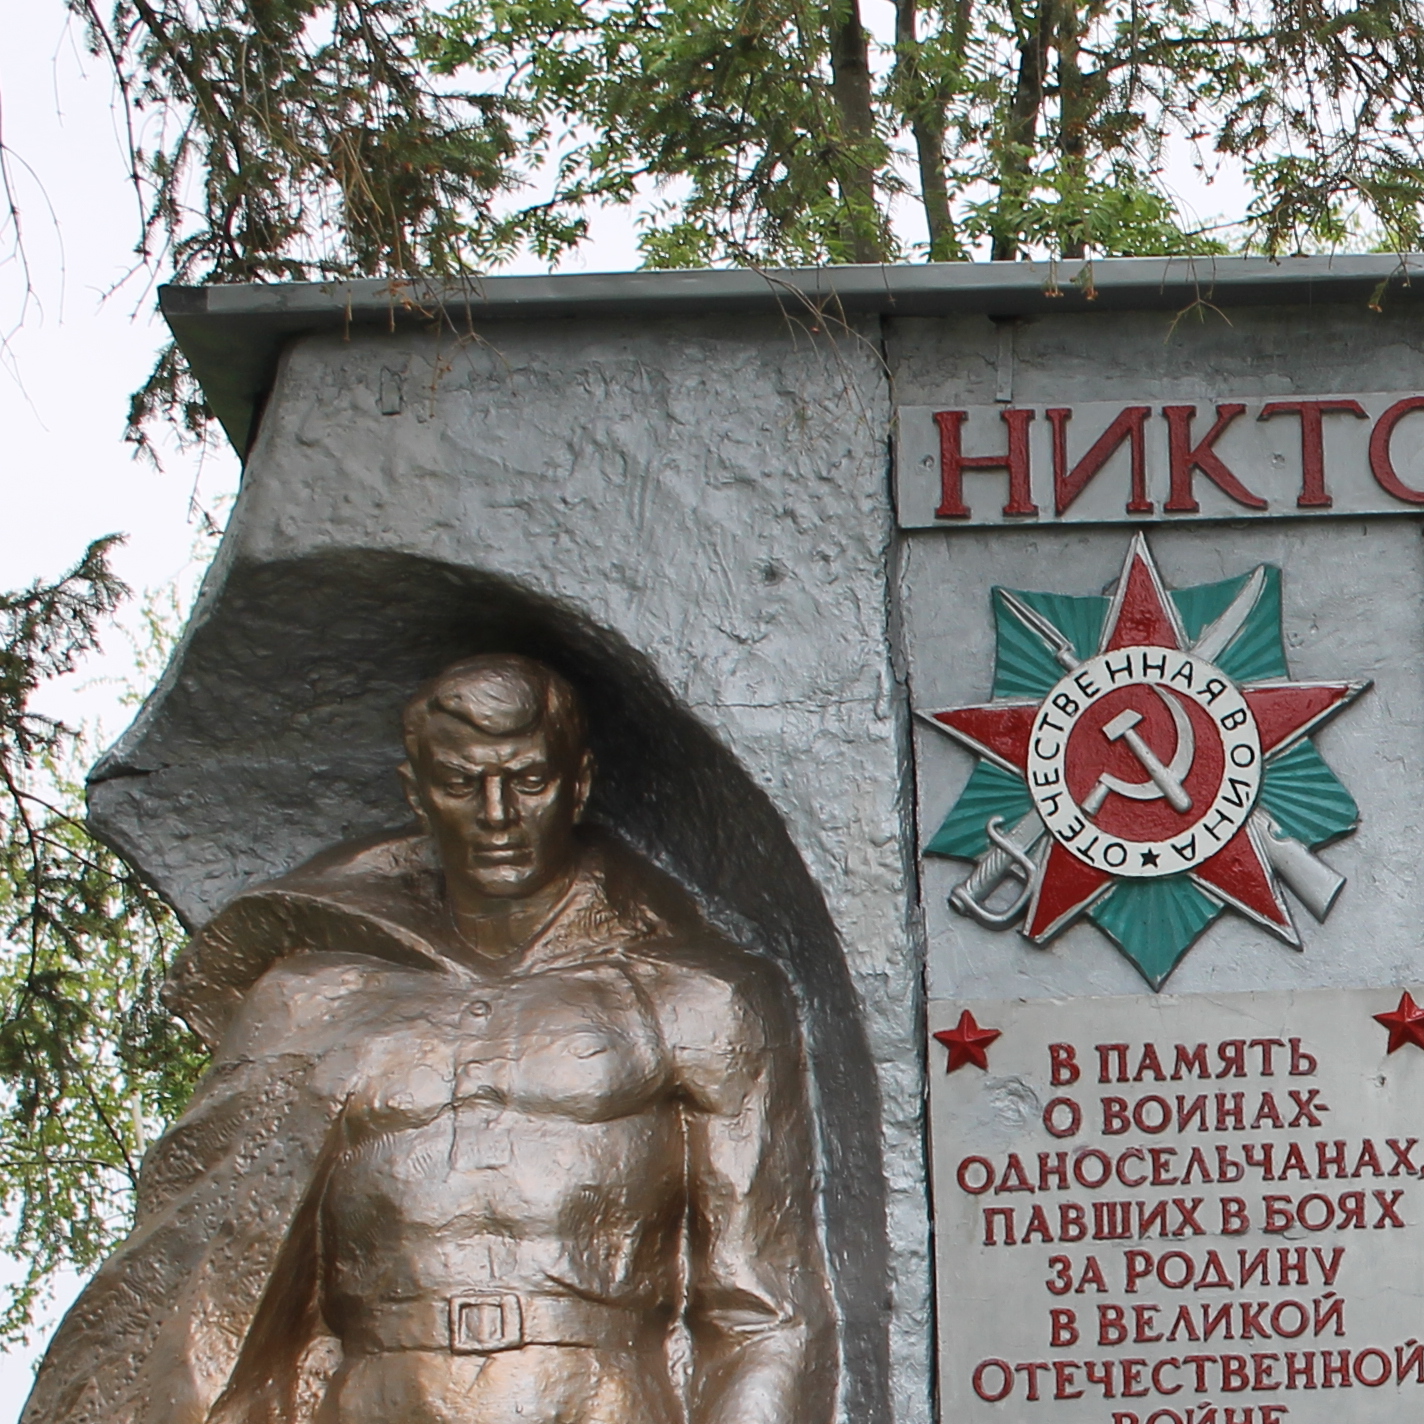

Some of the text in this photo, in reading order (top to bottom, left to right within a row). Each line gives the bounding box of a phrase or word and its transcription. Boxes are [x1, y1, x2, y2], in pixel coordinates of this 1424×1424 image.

[1034, 652, 1255, 868] ОТЕЧЕСТВЕННАЯ ВОЙНА
[1051, 1039, 1316, 1083] В ПАМЯТЬ
[1045, 1098, 1080, 1135] О
[986, 1191, 1402, 1243] ПАВШИХ В БОЯХ
[1048, 1248, 1343, 1293] ЗА РОДИНУ
[1052, 1291, 1343, 1345] В ВЕЛИКОЙ
[974, 1346, 1424, 1400] ОТЕЧЕСТВЕННОЙ
